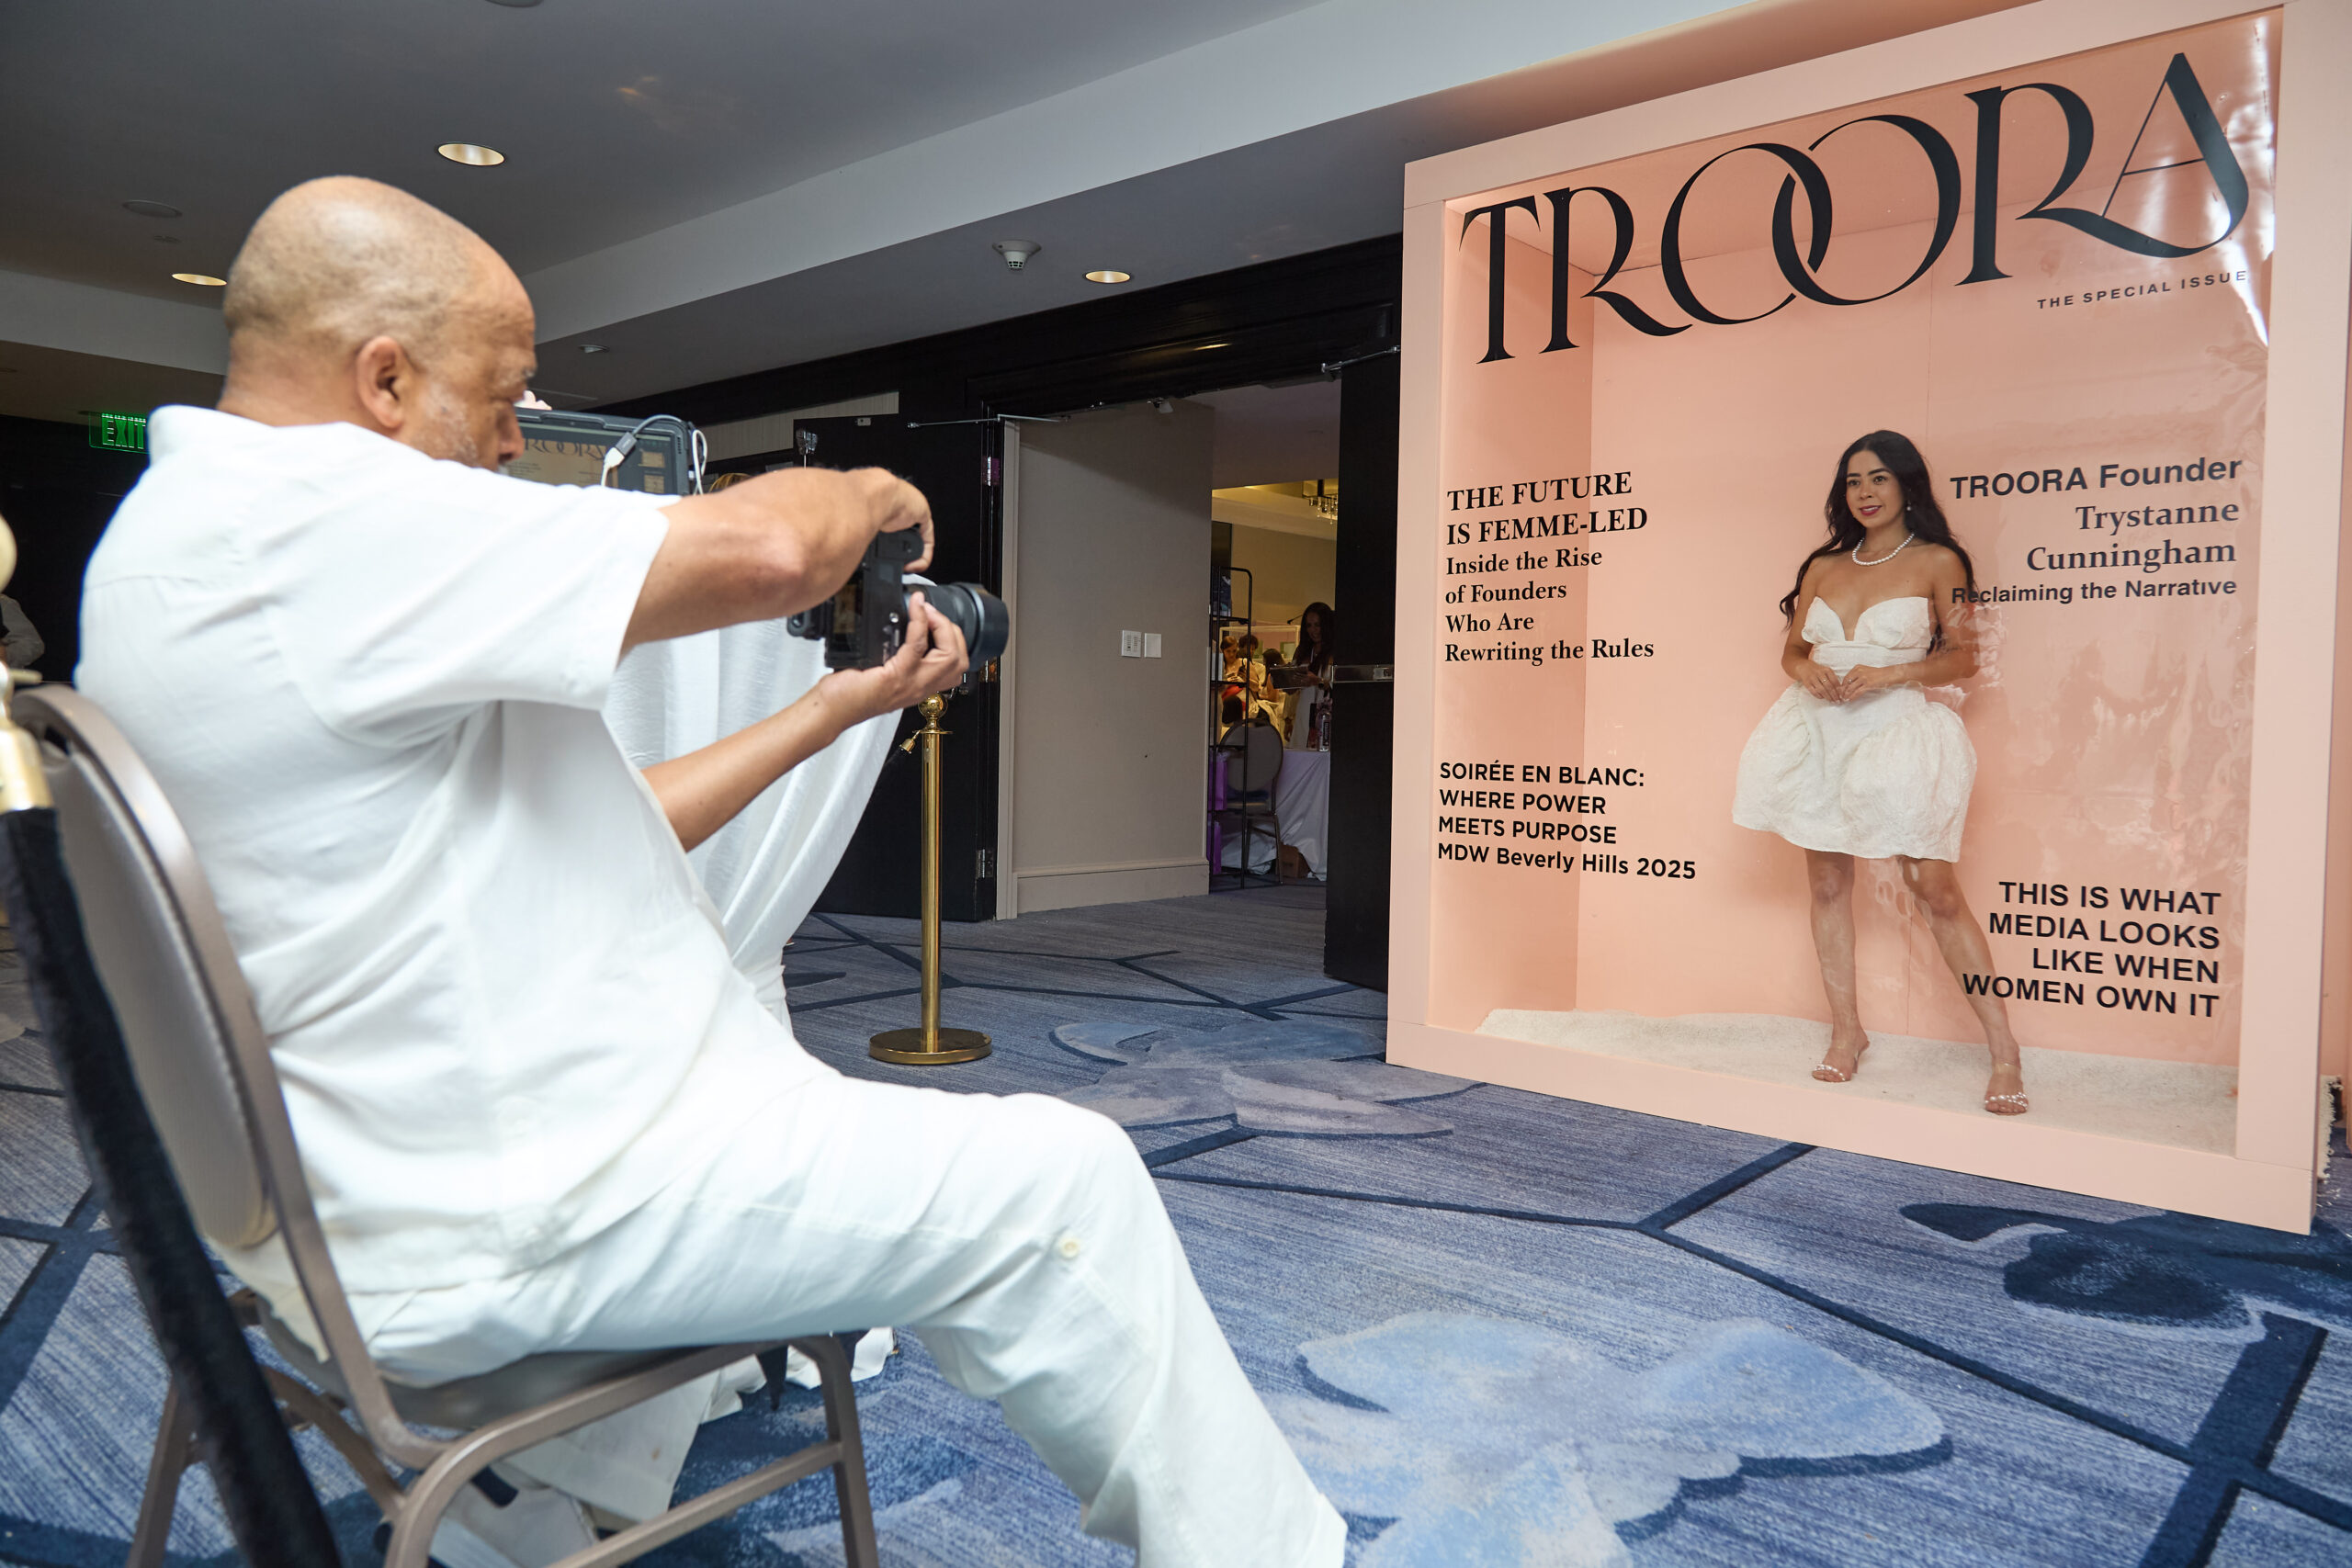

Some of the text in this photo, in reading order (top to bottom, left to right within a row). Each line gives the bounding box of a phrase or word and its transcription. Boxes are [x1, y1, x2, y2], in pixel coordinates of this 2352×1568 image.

[1459, 52, 2250, 365] TROORA
[2037, 270, 2246, 310] THE SPECIAL ISSUE
[102, 413, 146, 449] EXIT
[1447, 471, 1632, 512] THE FUTURE
[1950, 457, 2243, 500] TROORA Founder
[1446, 507, 1647, 546] IS FEMME-LED
[2075, 502, 2240, 536] Trystanne
[1446, 547, 1602, 575] Inside the Rise
[2027, 538, 2236, 574] Cunningham
[1445, 581, 1567, 604] of Founders
[1951, 578, 2237, 604] Reclaiming the Narrative
[1445, 612, 1535, 633] Who Are
[1444, 637, 1654, 667] Rewriting the Rules
[1440, 758, 1645, 787] SOIRÉE EN BLANC:
[1439, 789, 1607, 815] WHERE POWER
[1439, 816, 1617, 844] MEETS PURPOSE
[1438, 842, 1696, 880] MDW Beverly Hills 2025
[1998, 881, 2222, 916] THIS IS WHAT
[1989, 912, 2221, 950] MEDIA LOOKS
[2032, 947, 2220, 984] LIKE WHEN
[1962, 973, 2221, 1018] WOMEN OWN IT
